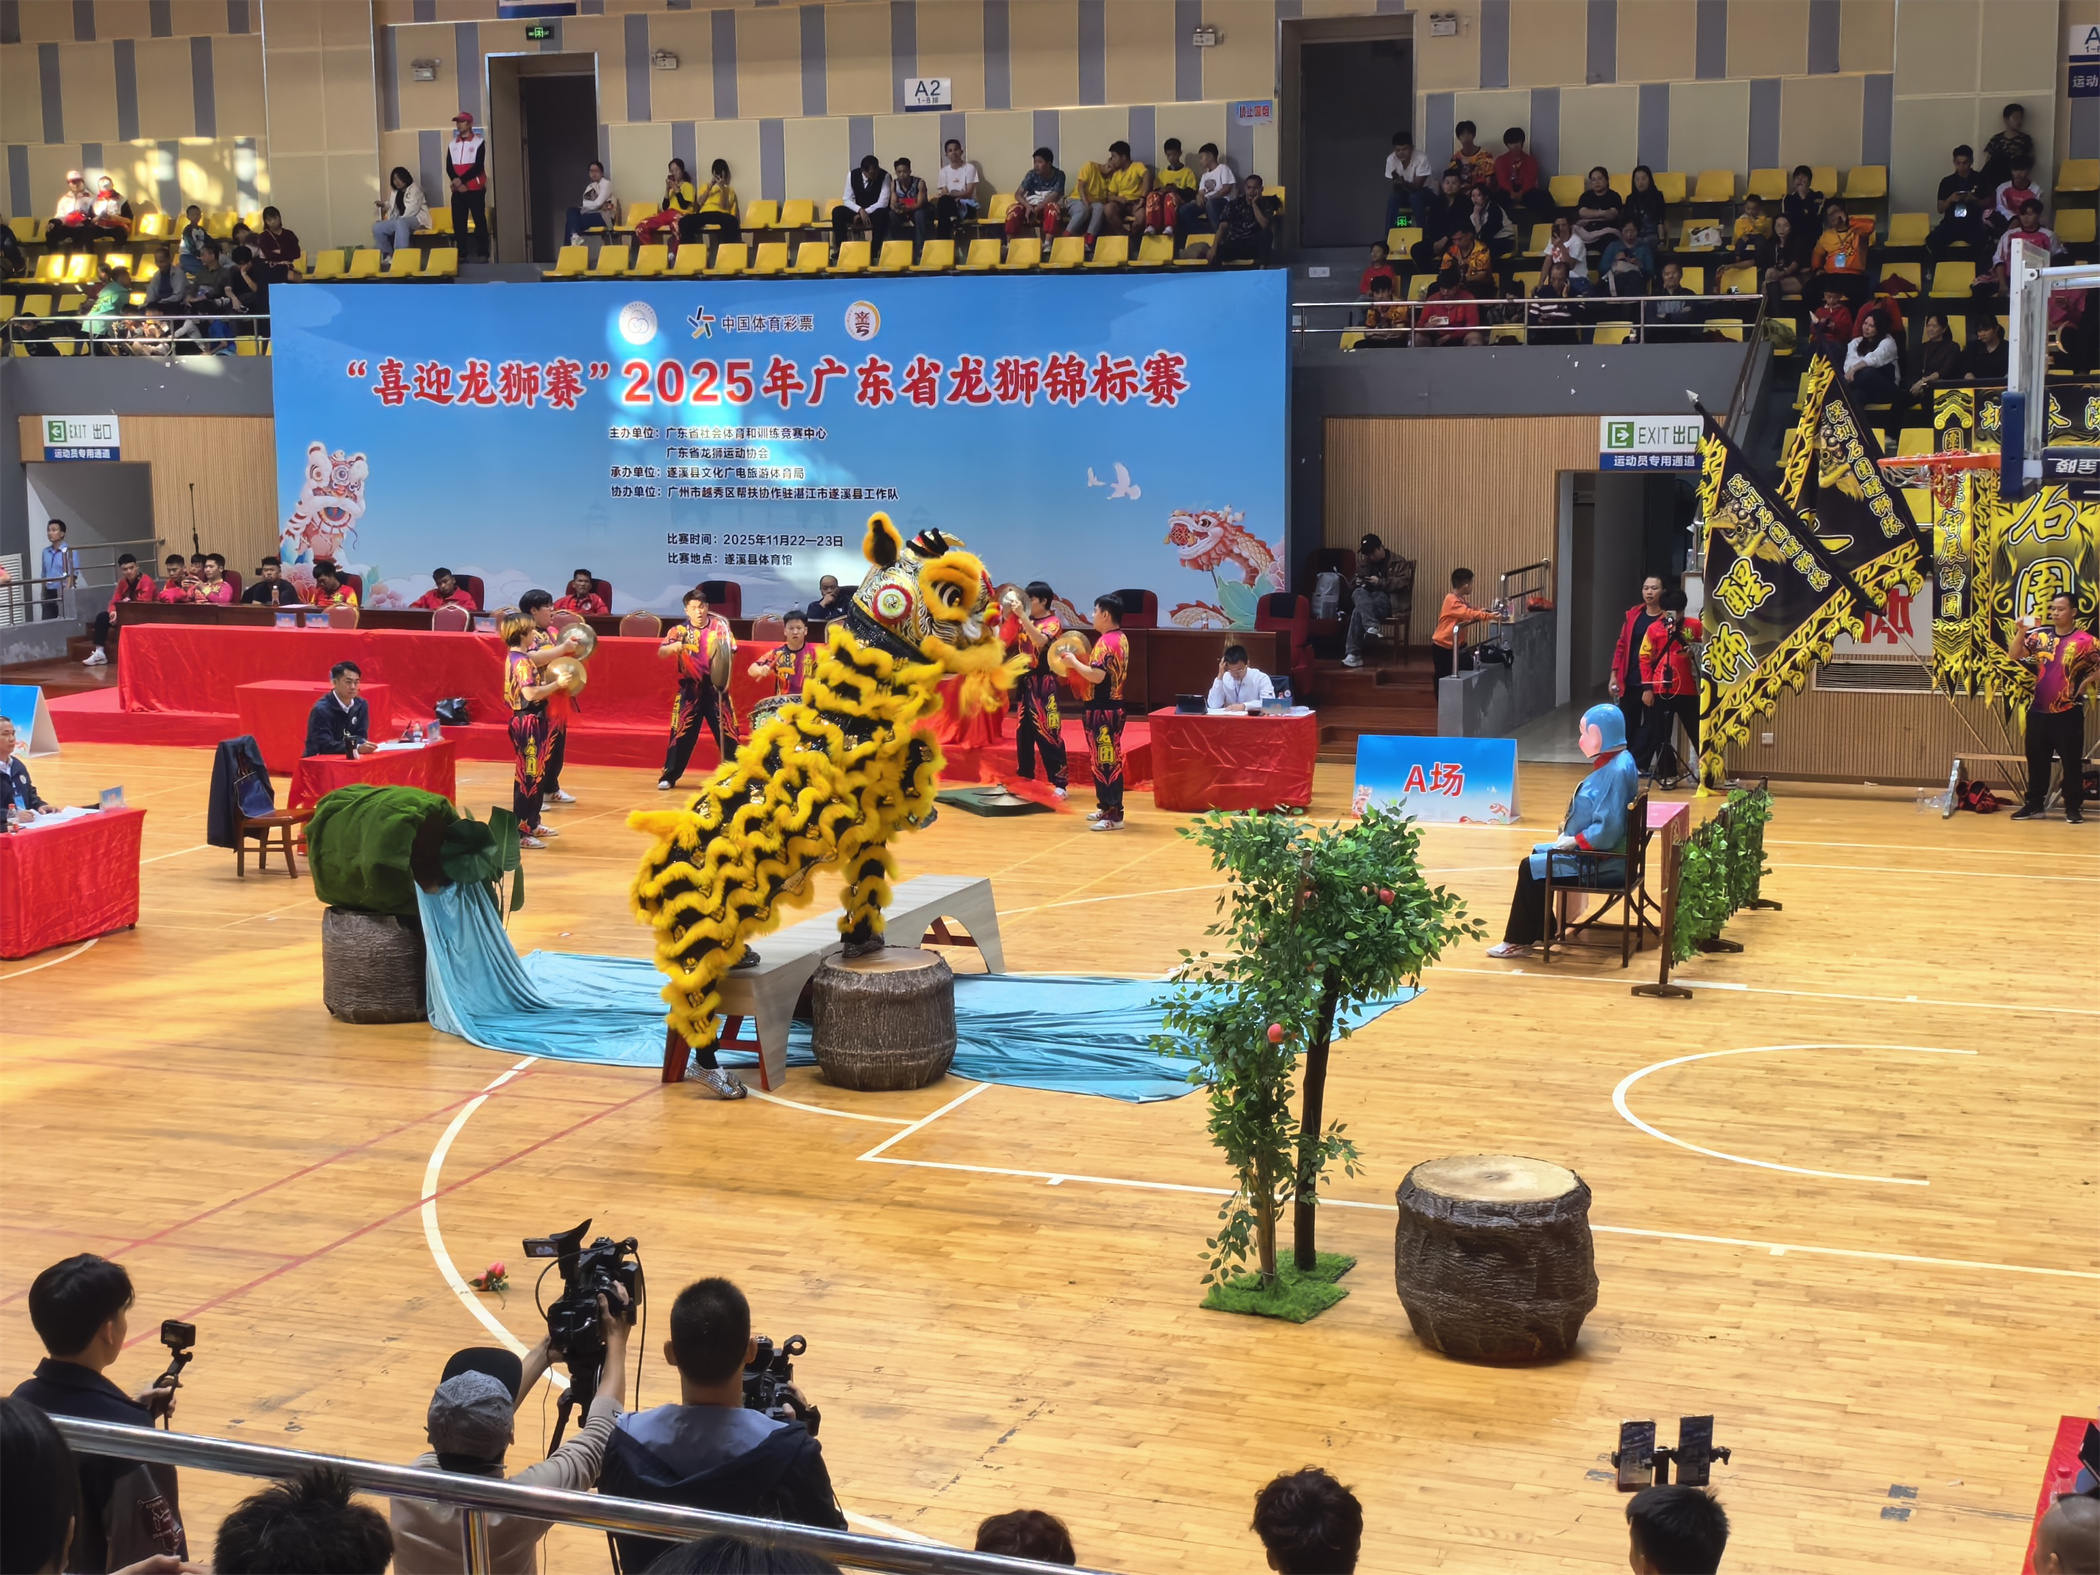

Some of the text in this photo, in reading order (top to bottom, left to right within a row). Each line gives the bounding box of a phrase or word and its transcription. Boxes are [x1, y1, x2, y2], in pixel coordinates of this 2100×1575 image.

[914, 79, 941, 97] A2
[721, 314, 814, 333] 中国体育彩票
[69, 423, 112, 440] EXIT 出口
[1638, 425, 1700, 444] EXIT 出口
[54, 448, 111, 459] 运动员专用通道
[666, 446, 769, 459] 广东省龙狮运动协会
[1613, 455, 1695, 467] 运动员专用通道
[1403, 762, 1465, 797] A场
